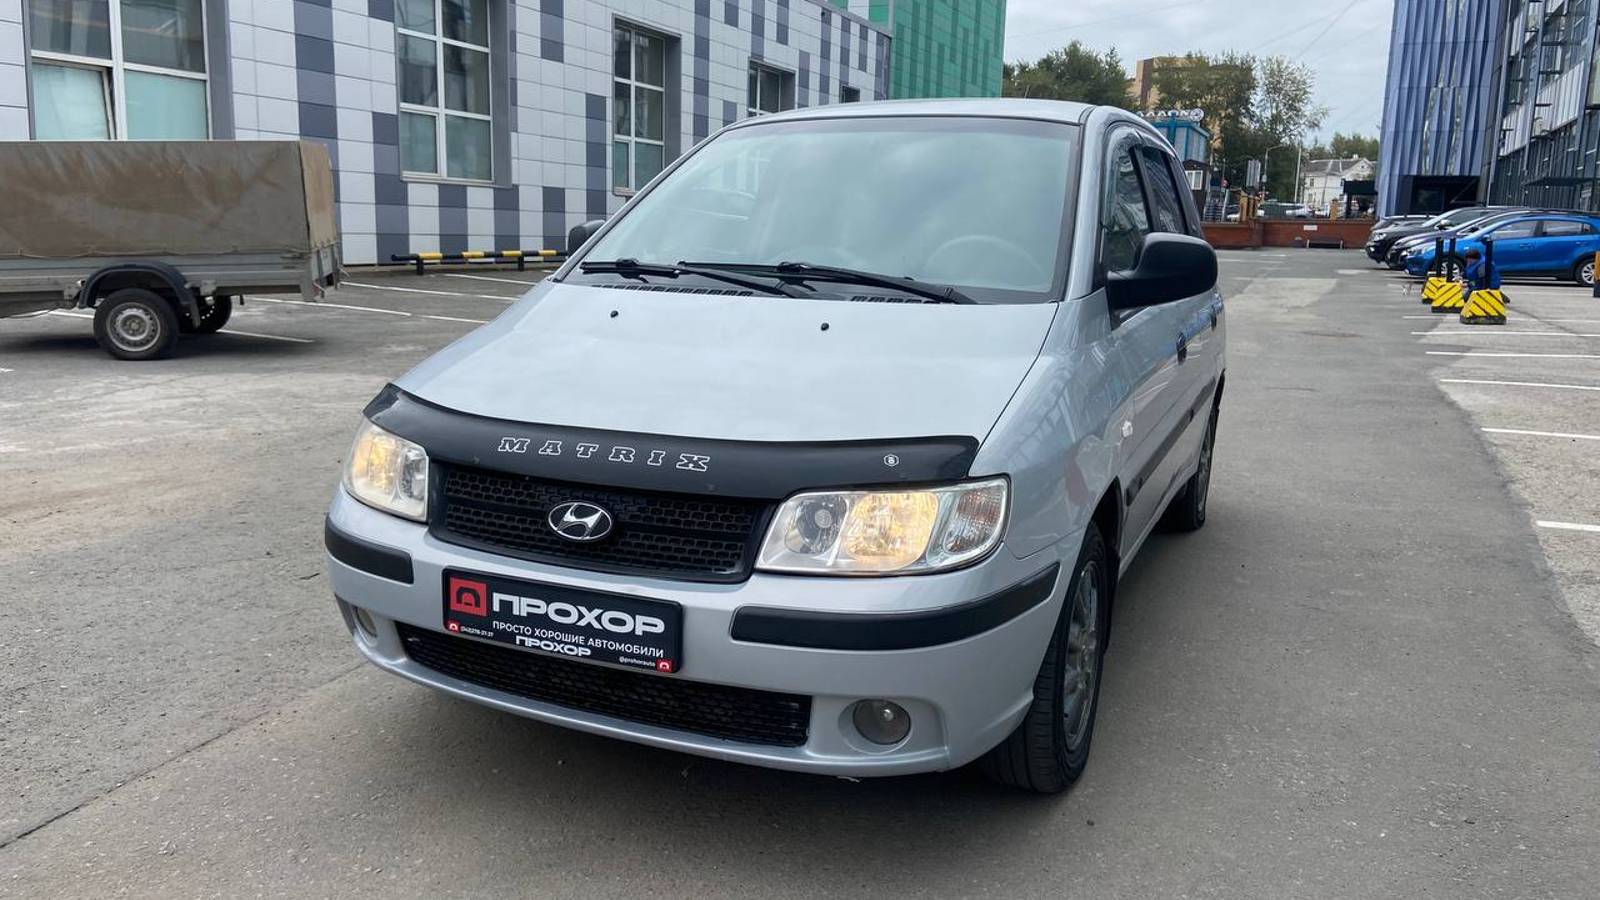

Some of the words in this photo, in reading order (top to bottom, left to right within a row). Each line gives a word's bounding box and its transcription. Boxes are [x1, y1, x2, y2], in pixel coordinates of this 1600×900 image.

[498, 437, 710, 471] MATRIX
[492, 592, 665, 635] ПРОХОР
[493, 621, 532, 636] ПРОСТО
[534, 627, 585, 645] ХОРОШИЕ
[588, 637, 664, 658] АВТОМОБИЛИ
[515, 636, 592, 656] ПРОХОР
